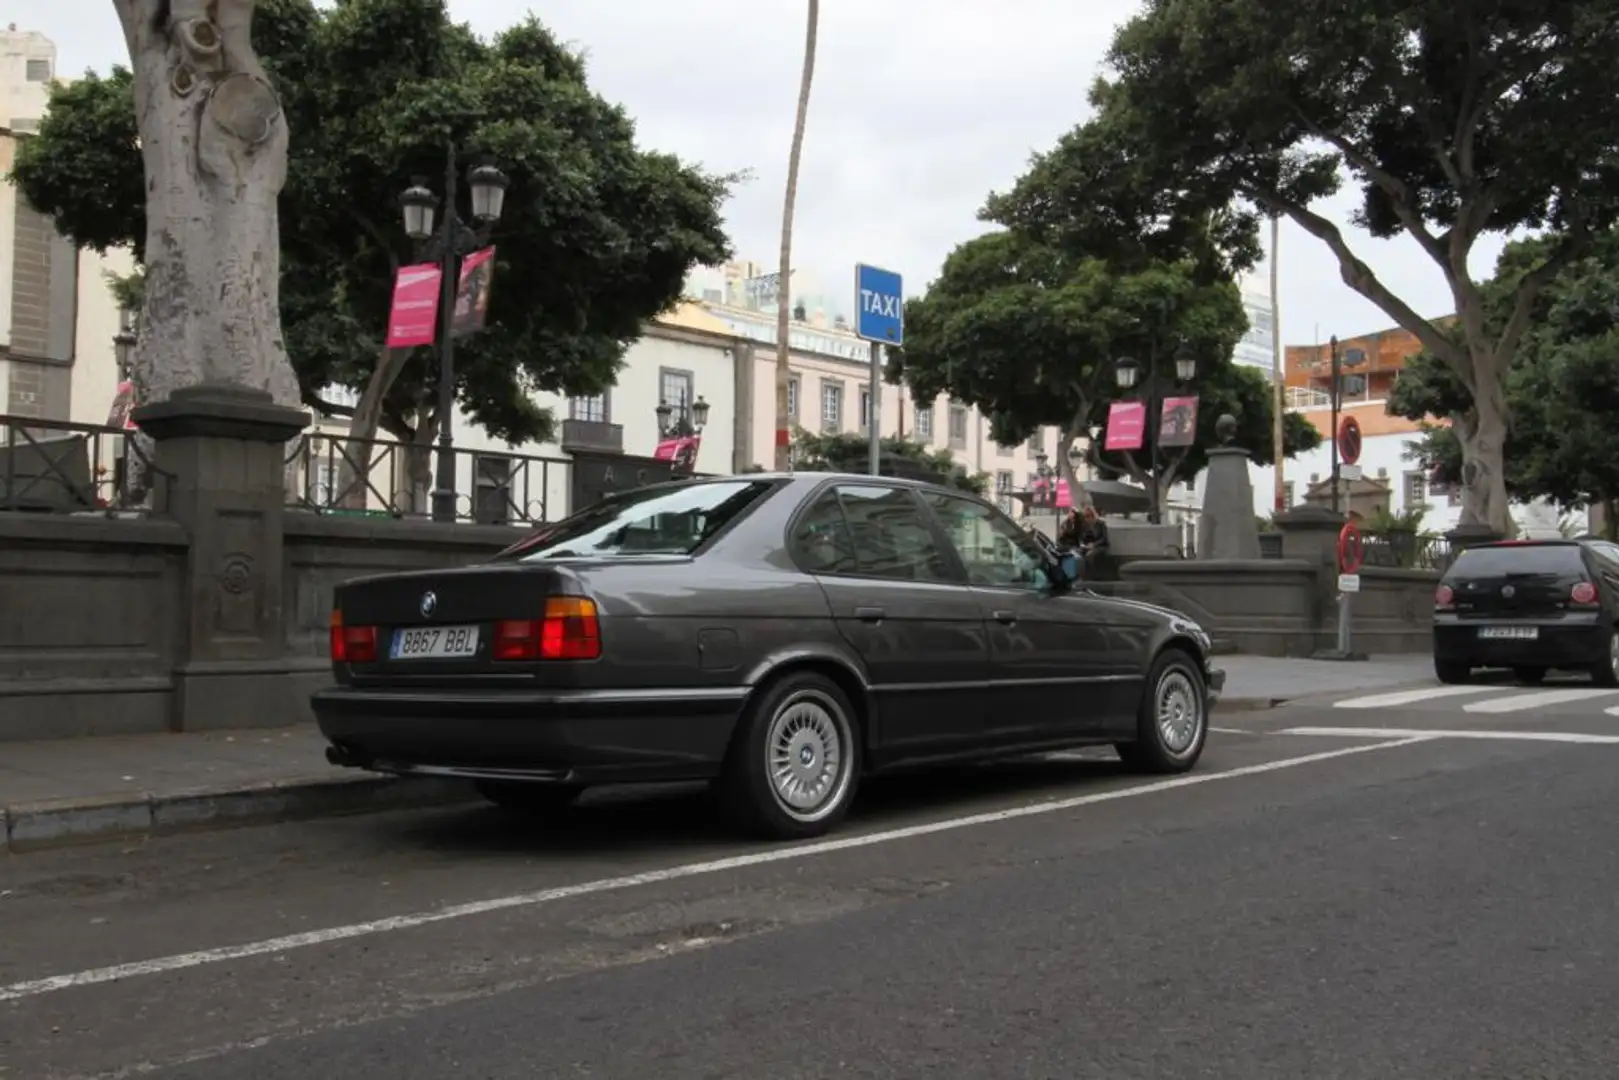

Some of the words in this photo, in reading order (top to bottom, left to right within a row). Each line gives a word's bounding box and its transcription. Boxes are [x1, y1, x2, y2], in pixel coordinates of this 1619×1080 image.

[860, 288, 901, 320] TAXI
[402, 630, 441, 654] 8867
[443, 628, 474, 653] BBL
